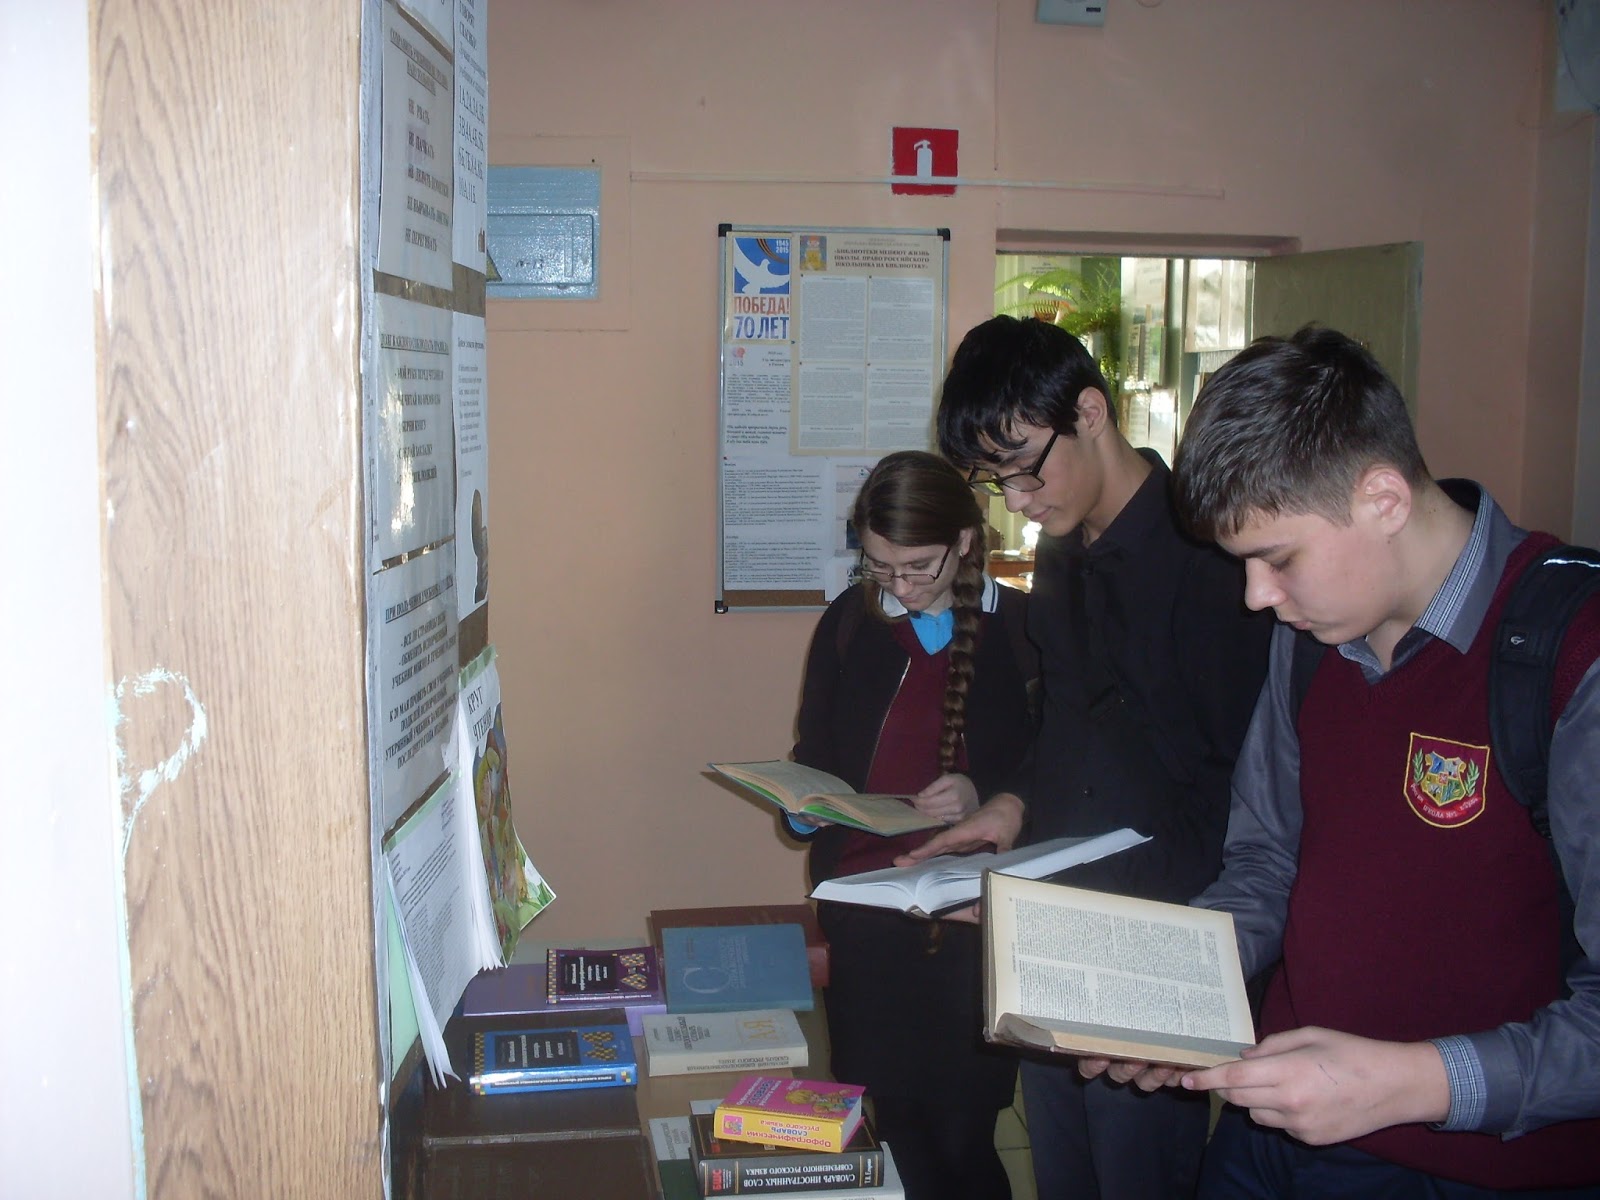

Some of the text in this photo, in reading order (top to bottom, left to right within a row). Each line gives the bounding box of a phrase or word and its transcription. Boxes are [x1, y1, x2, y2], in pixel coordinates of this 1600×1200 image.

[734, 296, 790, 316] ПОБЕДА!
[734, 316, 790, 339] 70 ЛЕТ
[385, 604, 396, 621] ПРИ
[385, 728, 413, 760] УТЕРЯННЫЙ
[786, 1122, 820, 1132] русского
[747, 1130, 832, 1148] Орфографический
[769, 1166, 801, 1174] РУССКОГО
[803, 1163, 853, 1172] СОВРЕМЕННОГО
[712, 1169, 722, 1190] БШС
[744, 1174, 855, 1188] СЛОВАРЬ ИНОСТРАННЫХ СЛОВ
